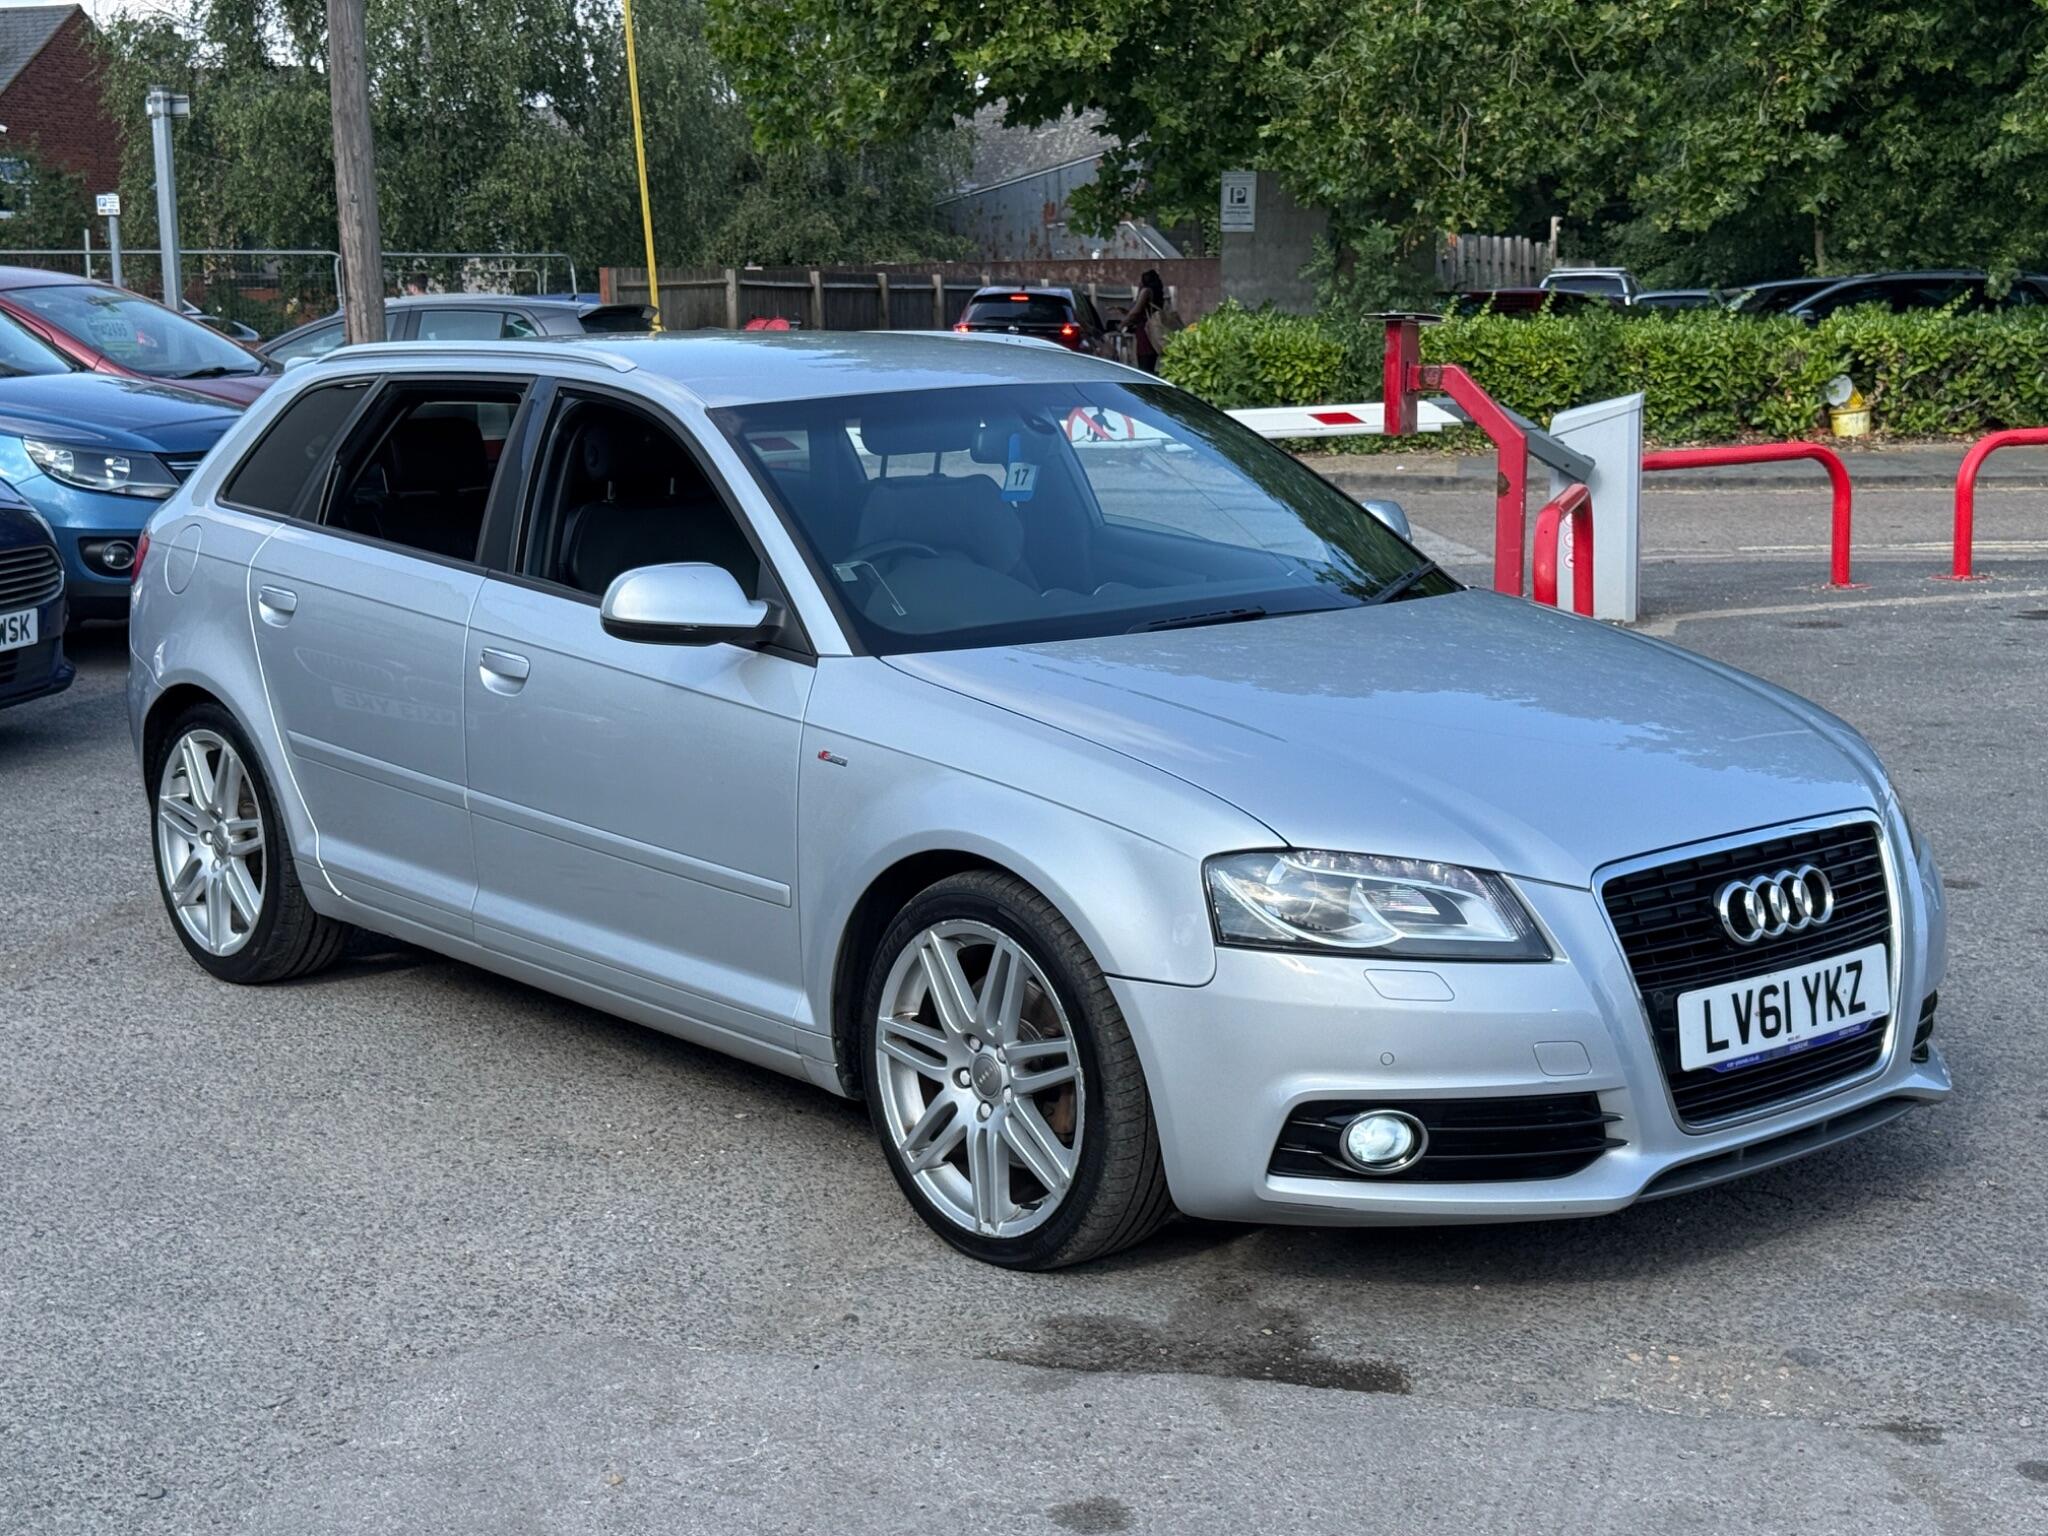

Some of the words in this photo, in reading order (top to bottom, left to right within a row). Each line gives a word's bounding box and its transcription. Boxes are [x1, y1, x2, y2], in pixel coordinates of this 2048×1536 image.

[1232, 187, 1246, 204] P
[1014, 468, 1029, 486] 17
[1703, 980, 1793, 1054] LV61
[1801, 959, 1867, 1027] YKZ
